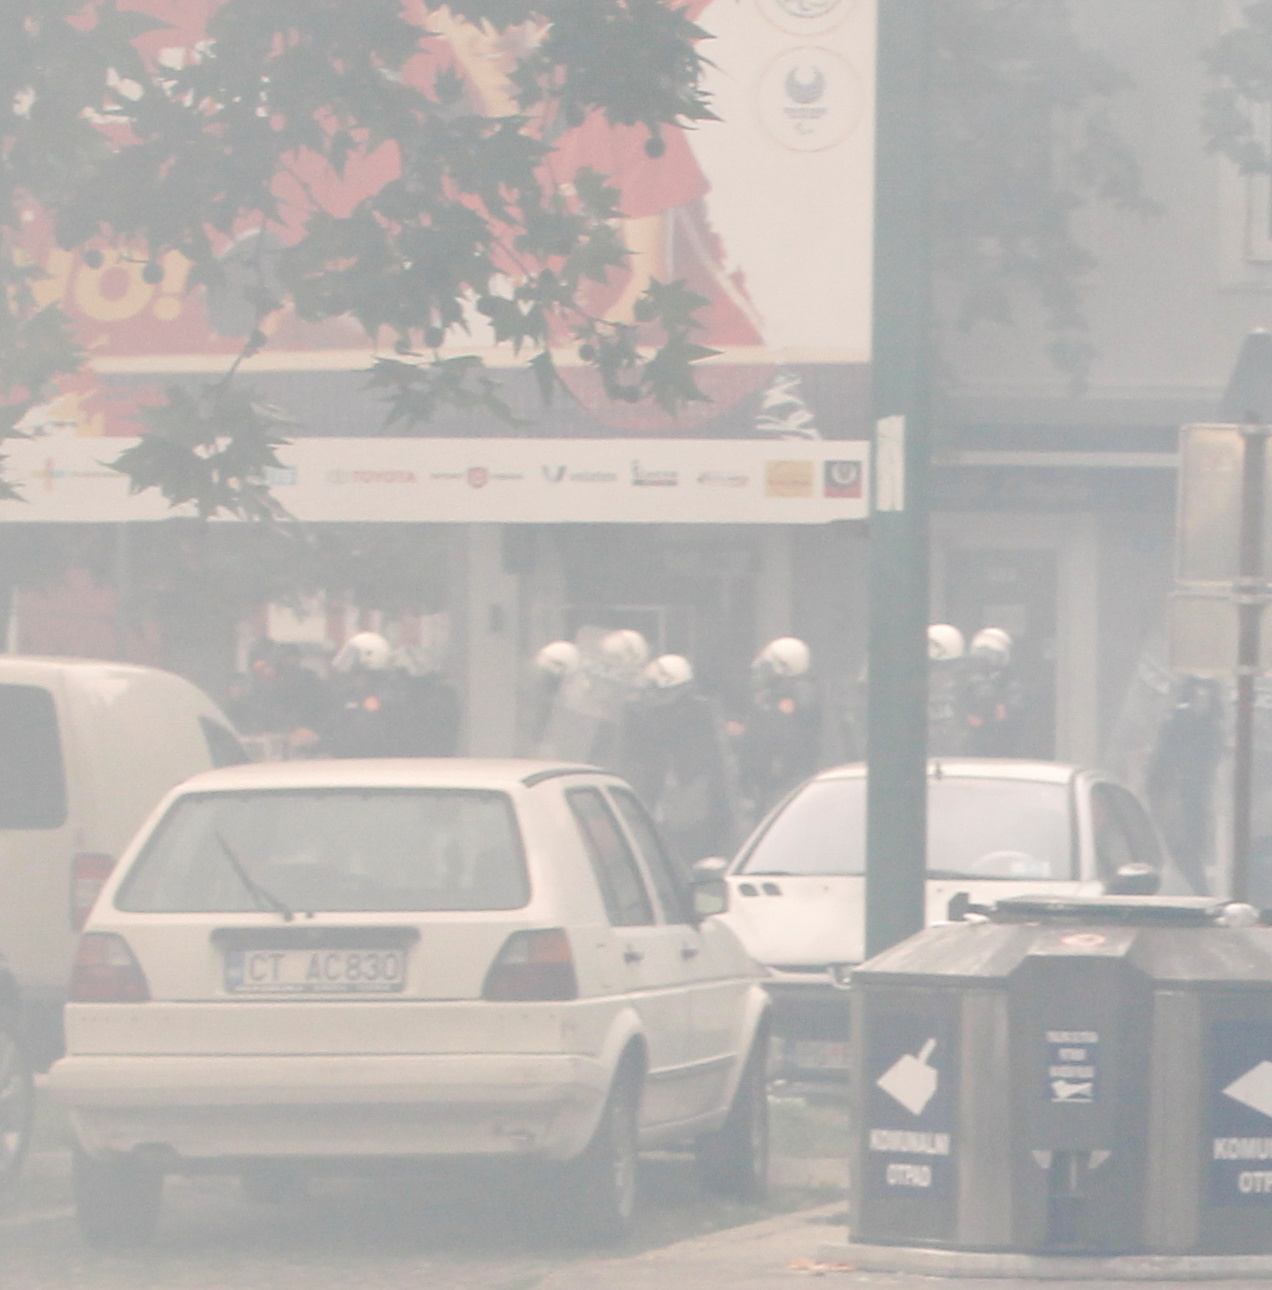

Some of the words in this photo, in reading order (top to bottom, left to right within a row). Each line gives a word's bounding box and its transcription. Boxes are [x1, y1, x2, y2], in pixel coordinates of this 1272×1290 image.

[250, 954, 285, 981] CT
[870, 1128, 950, 1155] KOMUNALNI
[887, 1163, 932, 1187] OTPAD
